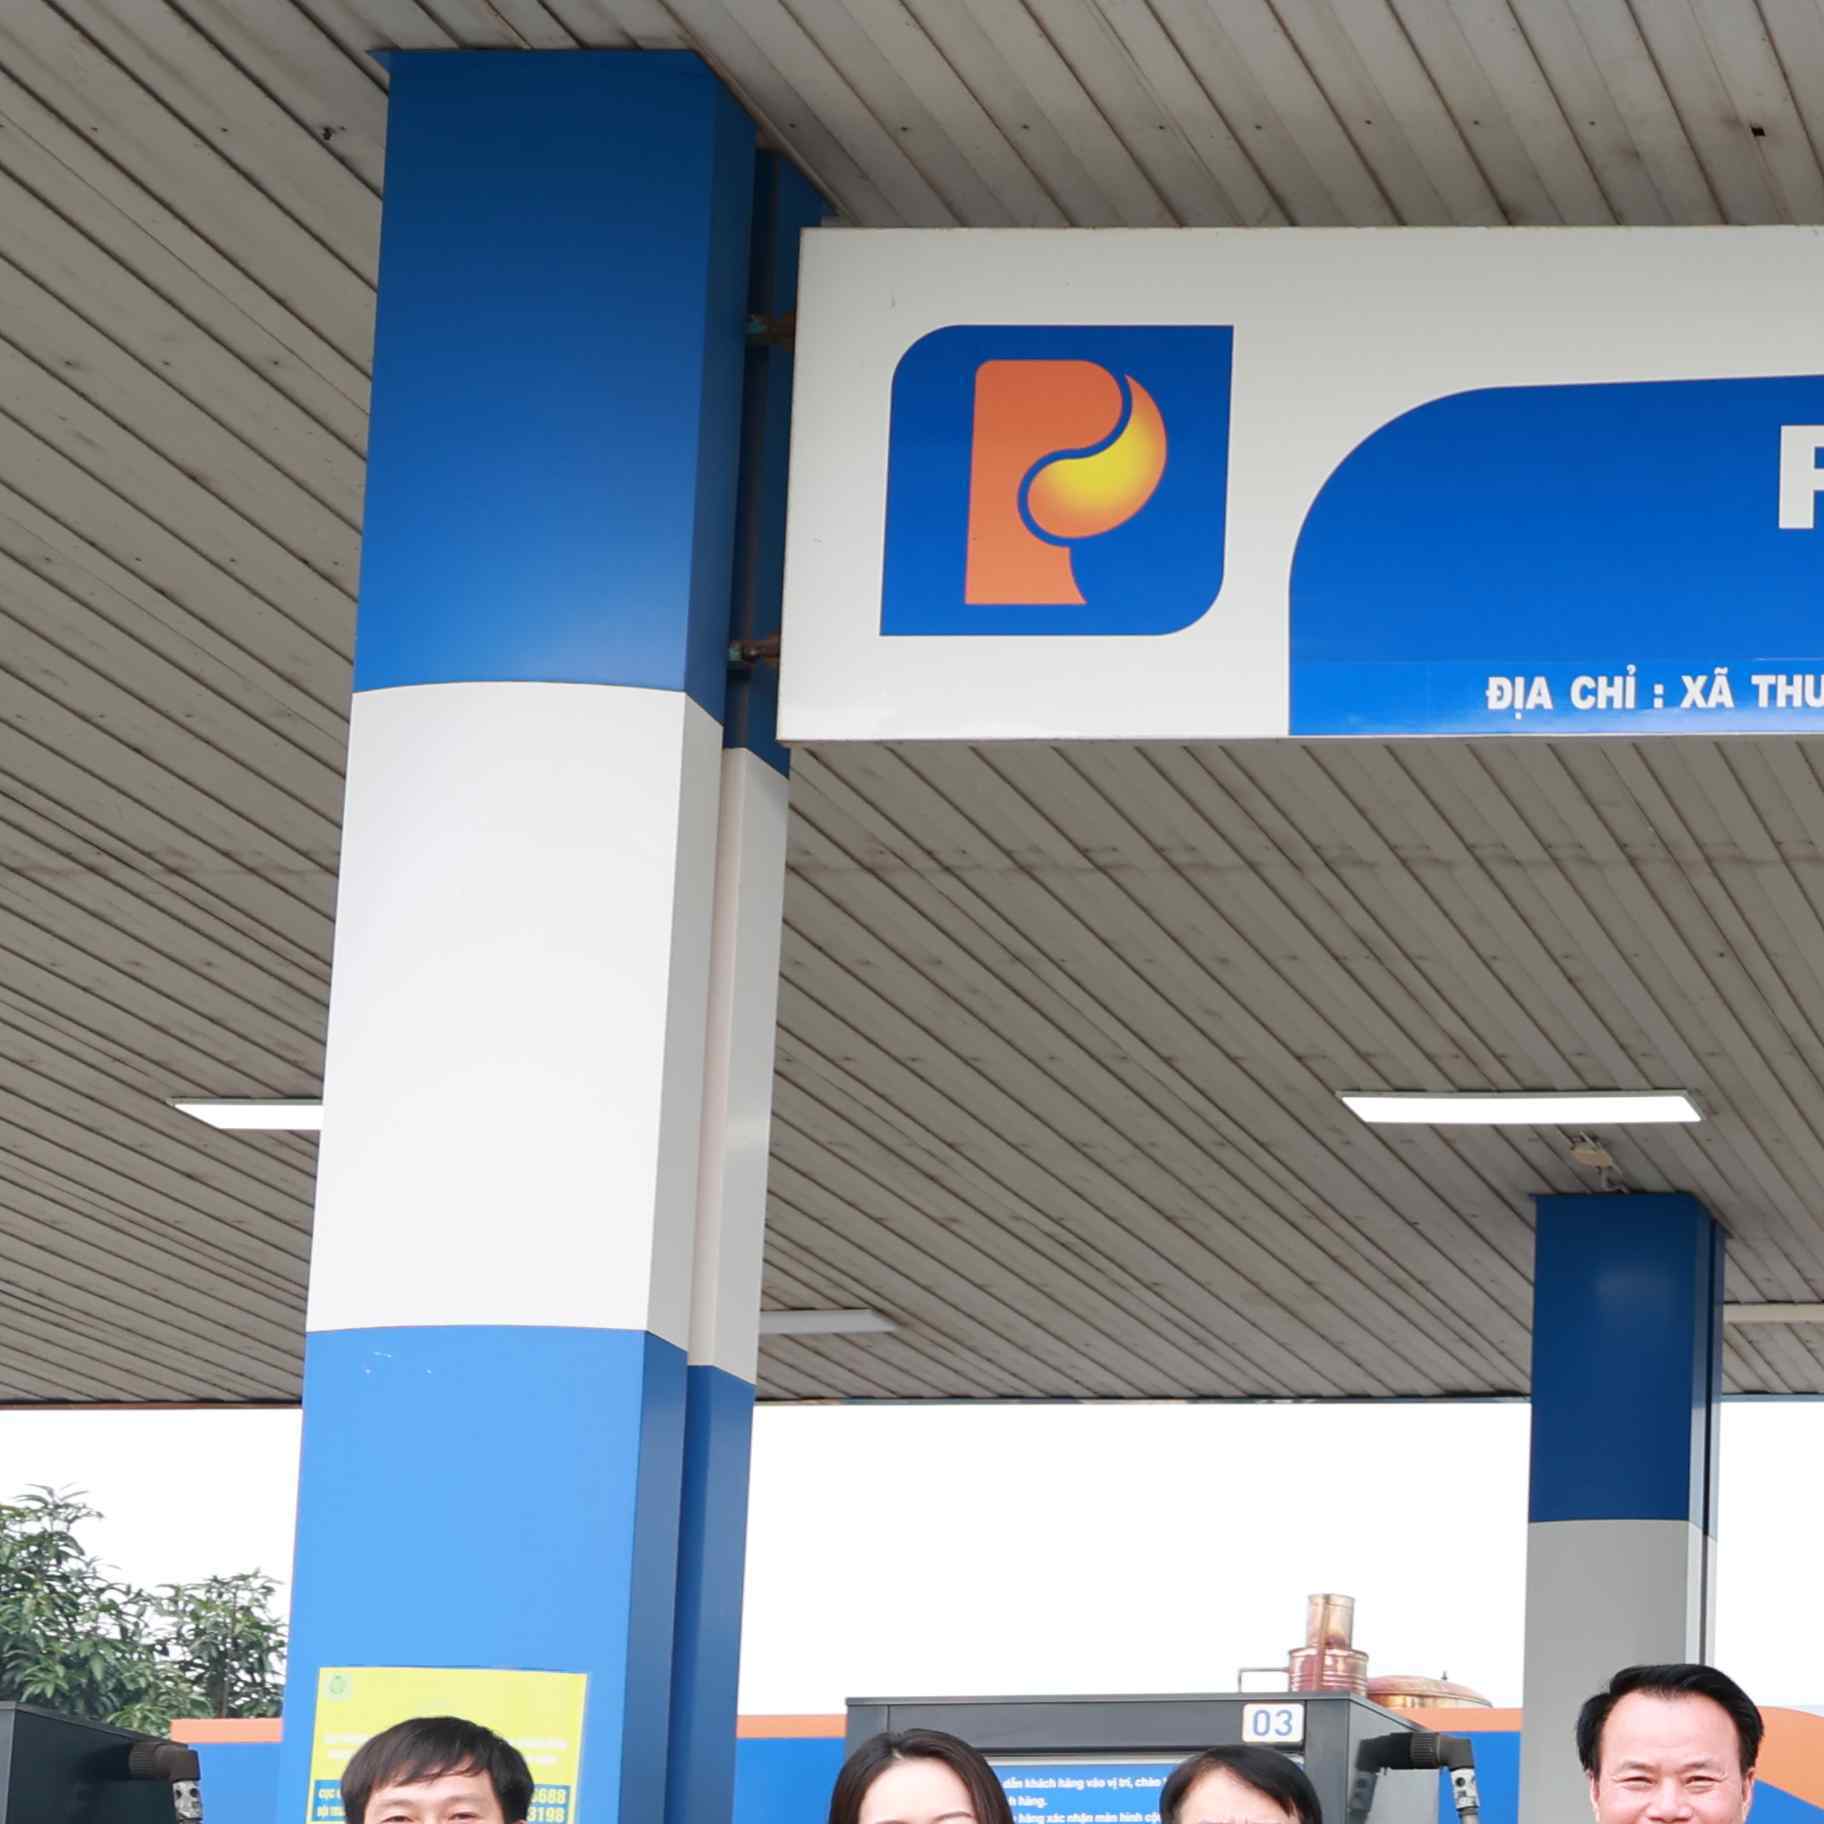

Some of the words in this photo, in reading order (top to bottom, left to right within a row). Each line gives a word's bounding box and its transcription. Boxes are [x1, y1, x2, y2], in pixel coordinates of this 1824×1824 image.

[1486, 674, 1553, 720] ĐỊA
[1570, 664, 1637, 709] CHỈ
[1680, 667, 1733, 709] XÃ
[1251, 1709, 1294, 1736] 03
[1057, 1778, 1085, 1791] hàng
